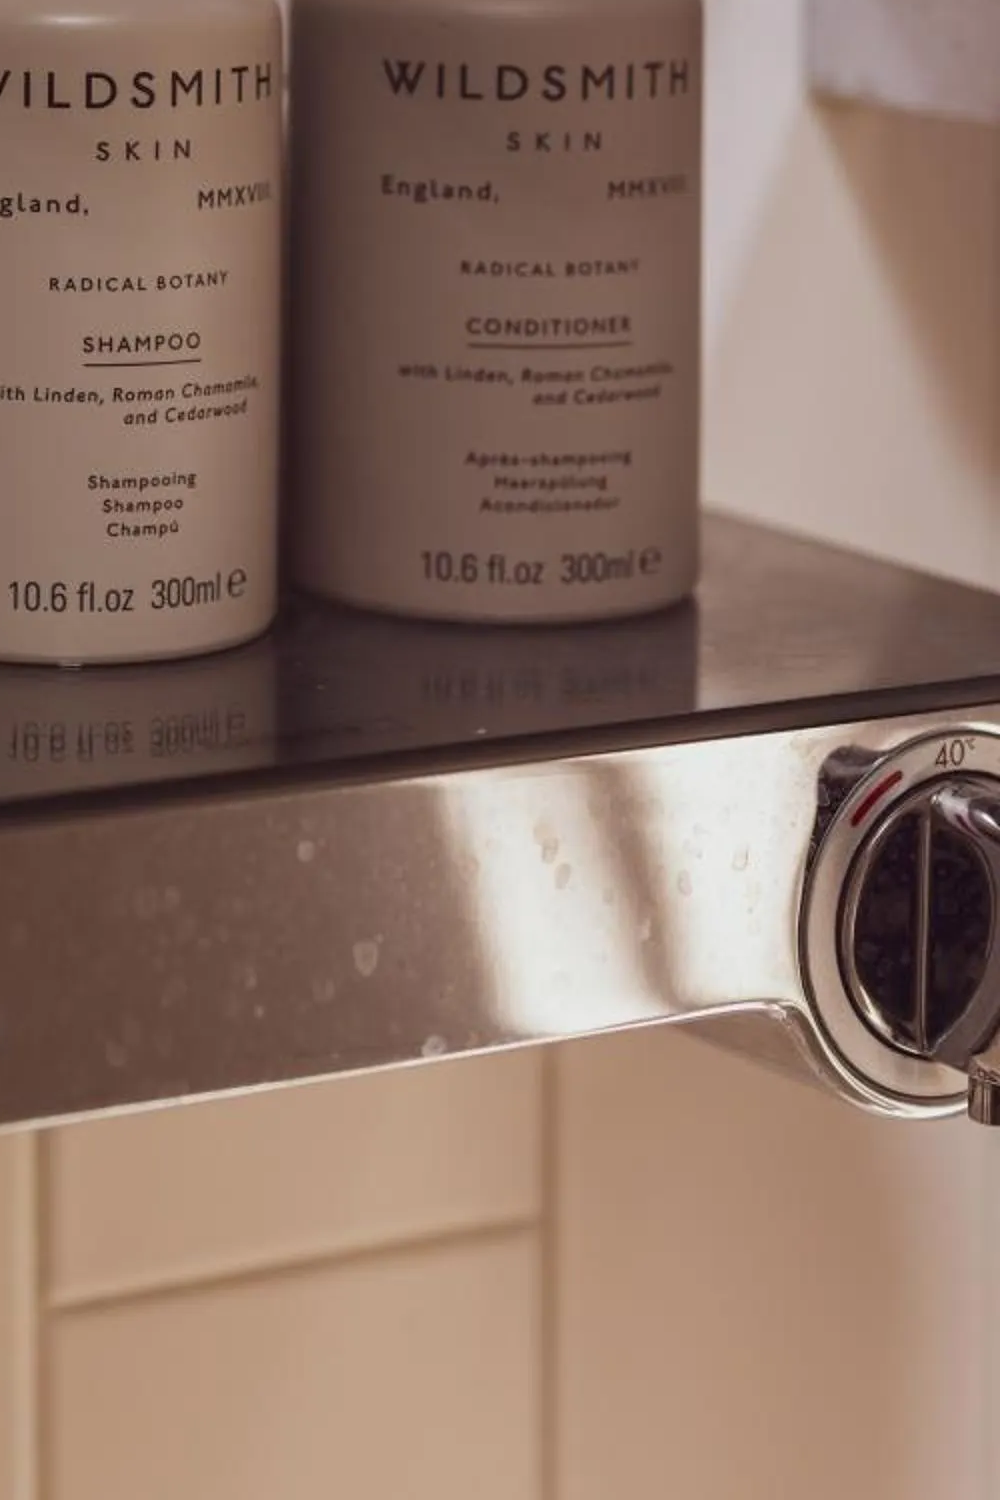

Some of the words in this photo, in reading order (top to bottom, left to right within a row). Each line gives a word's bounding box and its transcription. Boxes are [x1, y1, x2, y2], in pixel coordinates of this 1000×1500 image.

[382, 58, 689, 103] WILDSMITH
[94, 138, 191, 163] SKIN
[505, 130, 603, 153] SKIN
[380, 173, 500, 205] England,
[459, 259, 557, 278] RADICAL
[564, 258, 639, 278] BOTANY
[48, 275, 148, 293] RADICAL
[155, 270, 228, 292] BOTANY
[464, 315, 632, 338] CONDITIONER
[82, 331, 201, 354] SHAMPOO
[33, 386, 105, 406] Linden,
[111, 387, 176, 403] Roman
[122, 408, 159, 426] and
[87, 473, 197, 492] Shampooing
[101, 498, 184, 515] Shampoo
[105, 520, 180, 540] Champú
[420, 550, 479, 584] 10.6
[485, 553, 544, 586] fl.oz
[559, 548, 635, 585] 300ml
[8, 581, 68, 613] 10.6
[75, 580, 135, 613] fl.oz
[151, 573, 222, 610] 300ml
